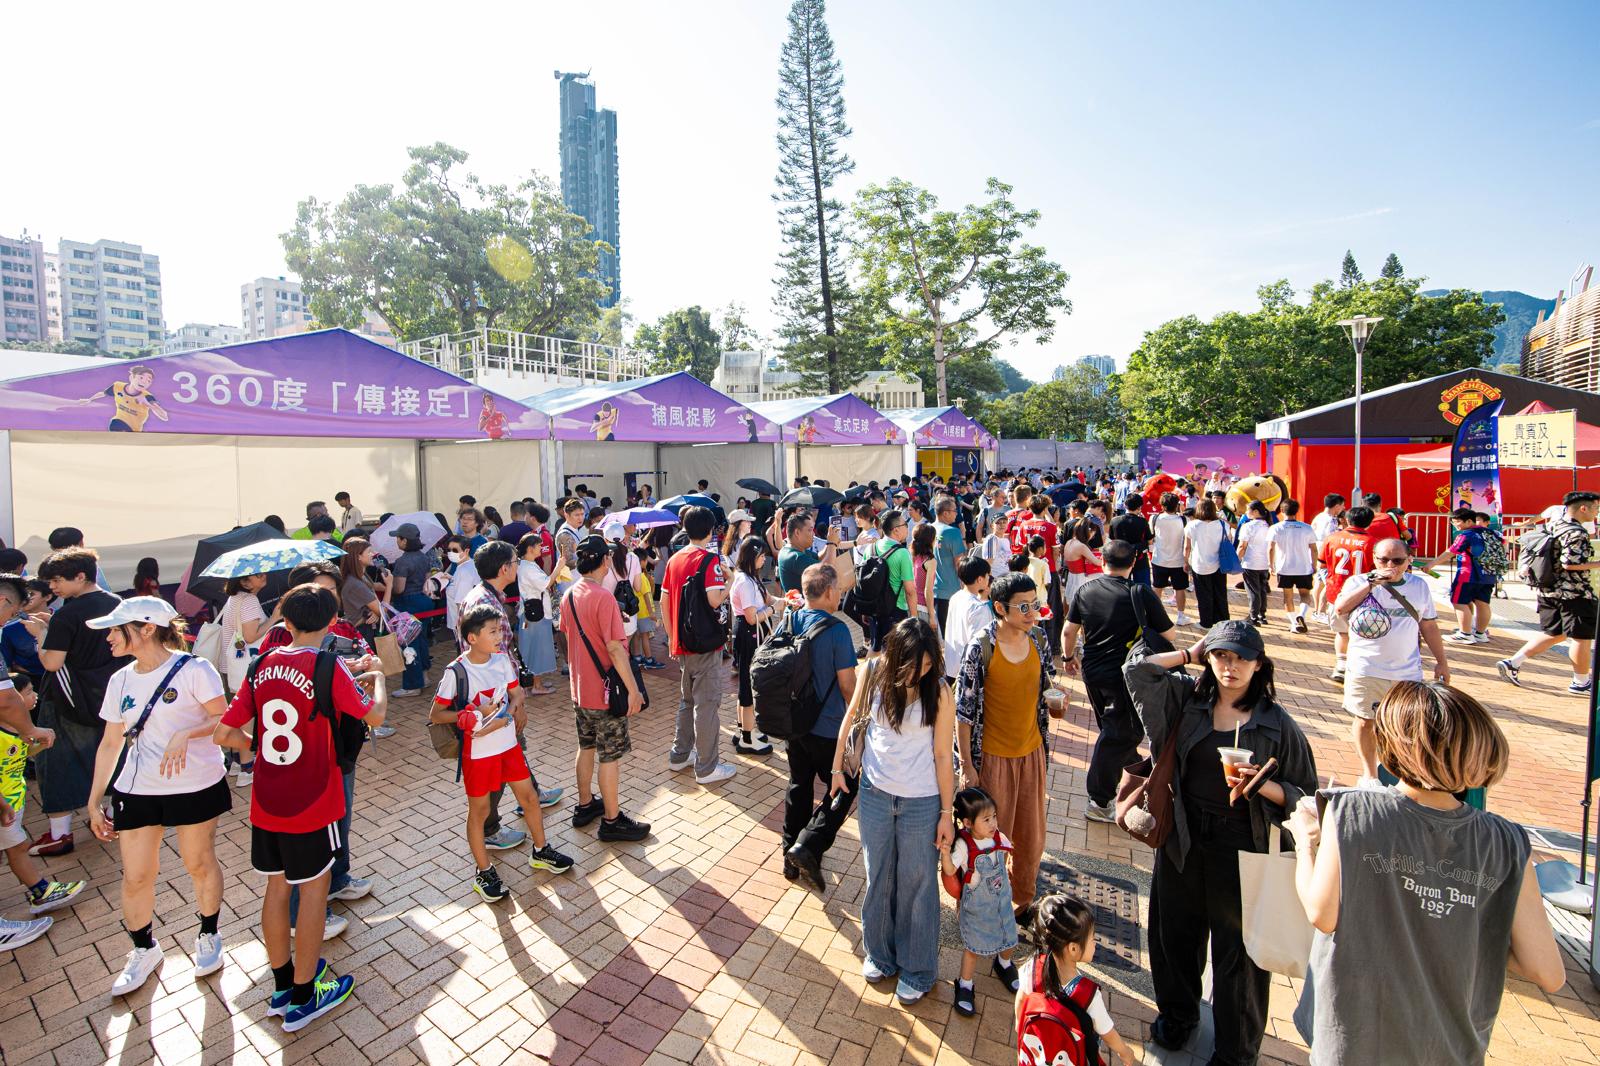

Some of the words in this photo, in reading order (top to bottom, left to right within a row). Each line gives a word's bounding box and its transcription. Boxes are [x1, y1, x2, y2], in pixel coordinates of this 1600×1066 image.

[1446, 382, 1497, 400] MANCHESTER
[651, 403, 716, 428] 捕風捉影
[834, 417, 870, 433] 桌式足球
[1515, 422, 1549, 440] 貴賓及
[1335, 548, 1364, 576] 21
[253, 665, 315, 700] FERNANDES
[261, 698, 303, 766] 8
[1400, 875, 1442, 899] Byron
[1445, 886, 1476, 908] Bay
[1420, 898, 1455, 916] 1987
